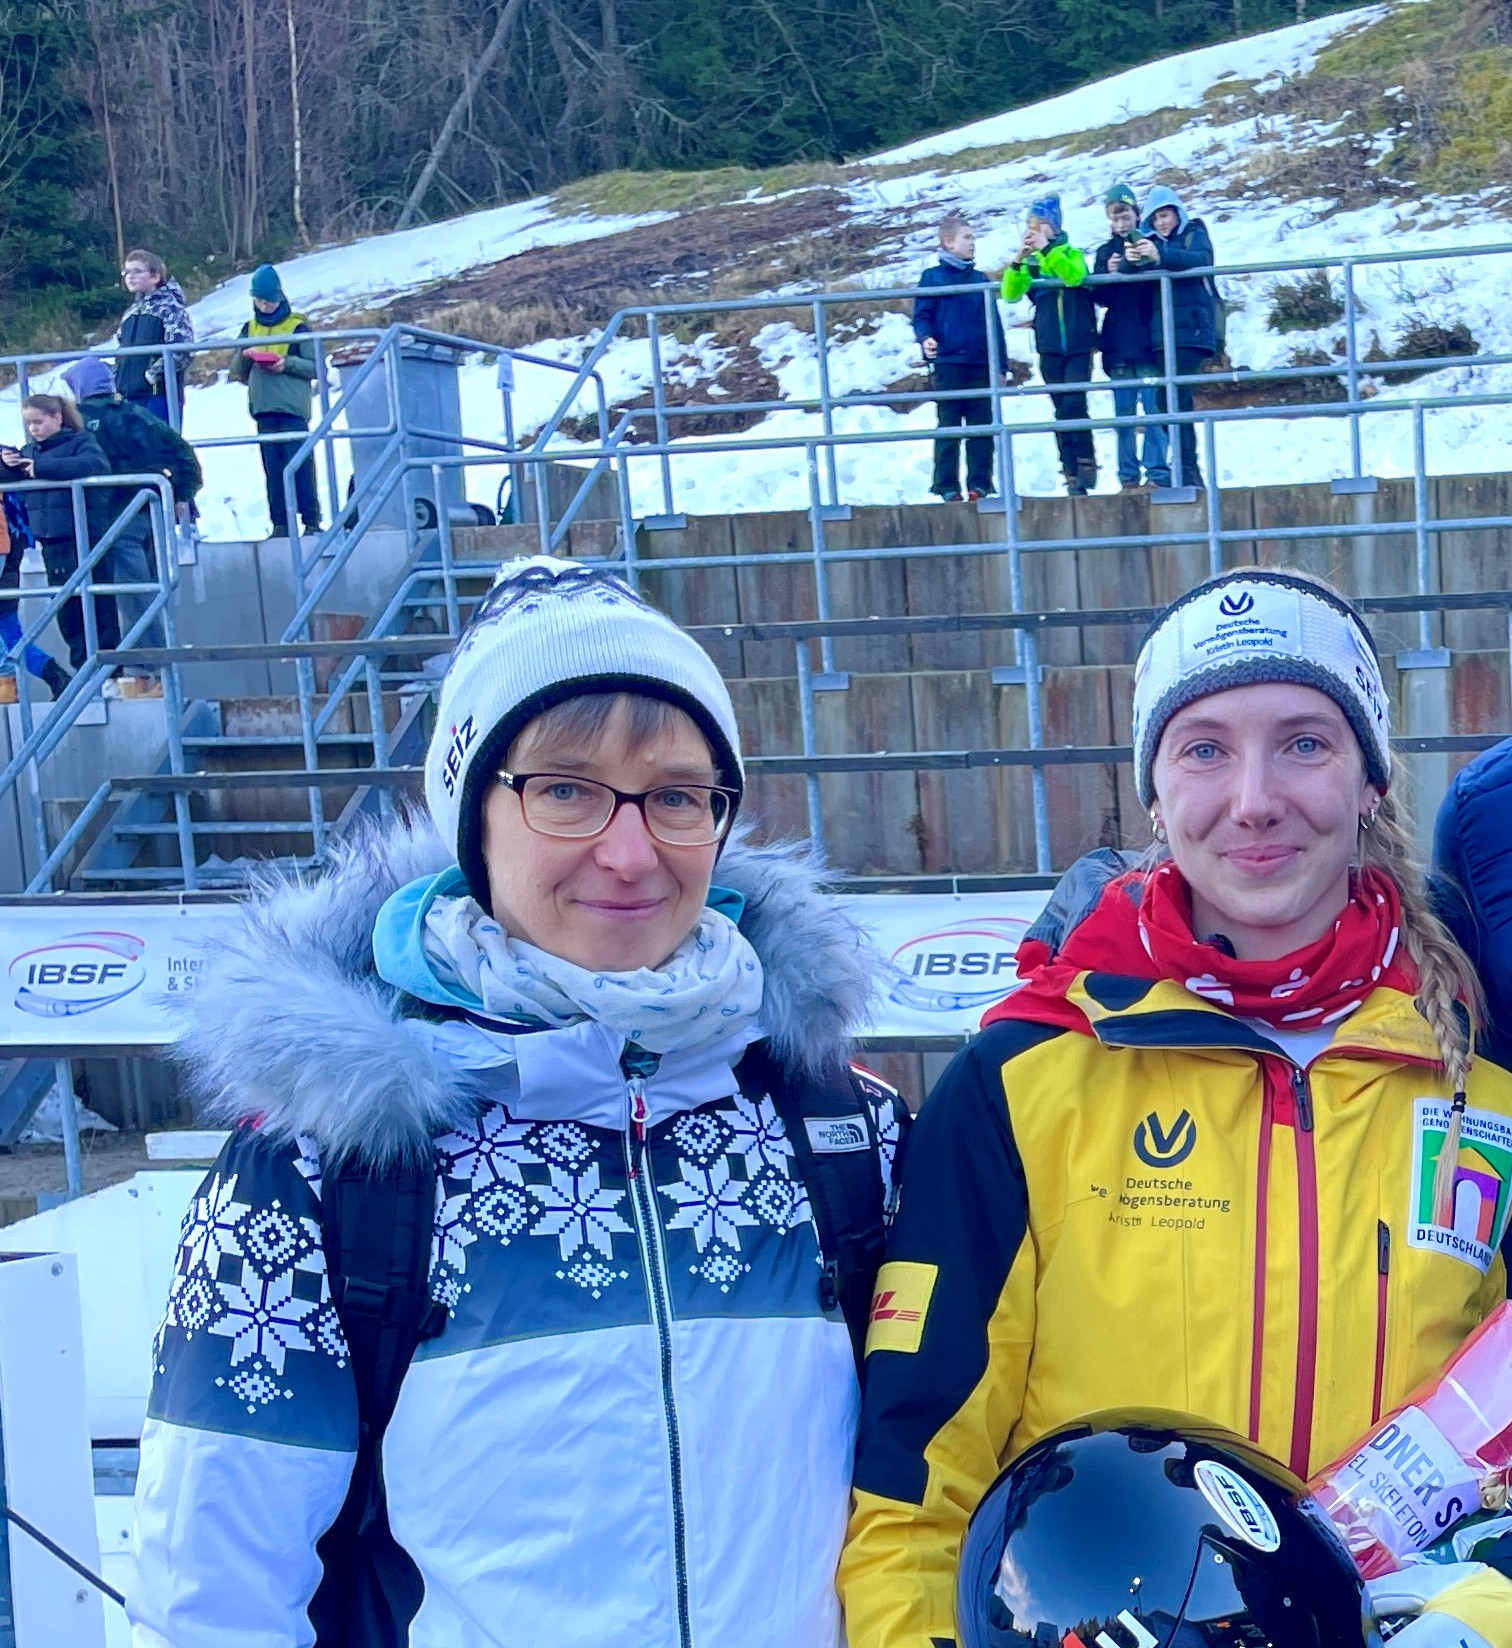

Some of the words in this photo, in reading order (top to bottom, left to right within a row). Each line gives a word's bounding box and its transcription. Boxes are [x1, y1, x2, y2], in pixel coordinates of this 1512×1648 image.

[168, 956, 210, 972] Inter
[28, 964, 127, 985] IBSF
[1422, 1107, 1440, 1117] DIE
[1126, 1177, 1193, 1191] Deutsche
[1151, 1216, 1205, 1231] Leopold
[1369, 1471, 1431, 1547] SKELETON
